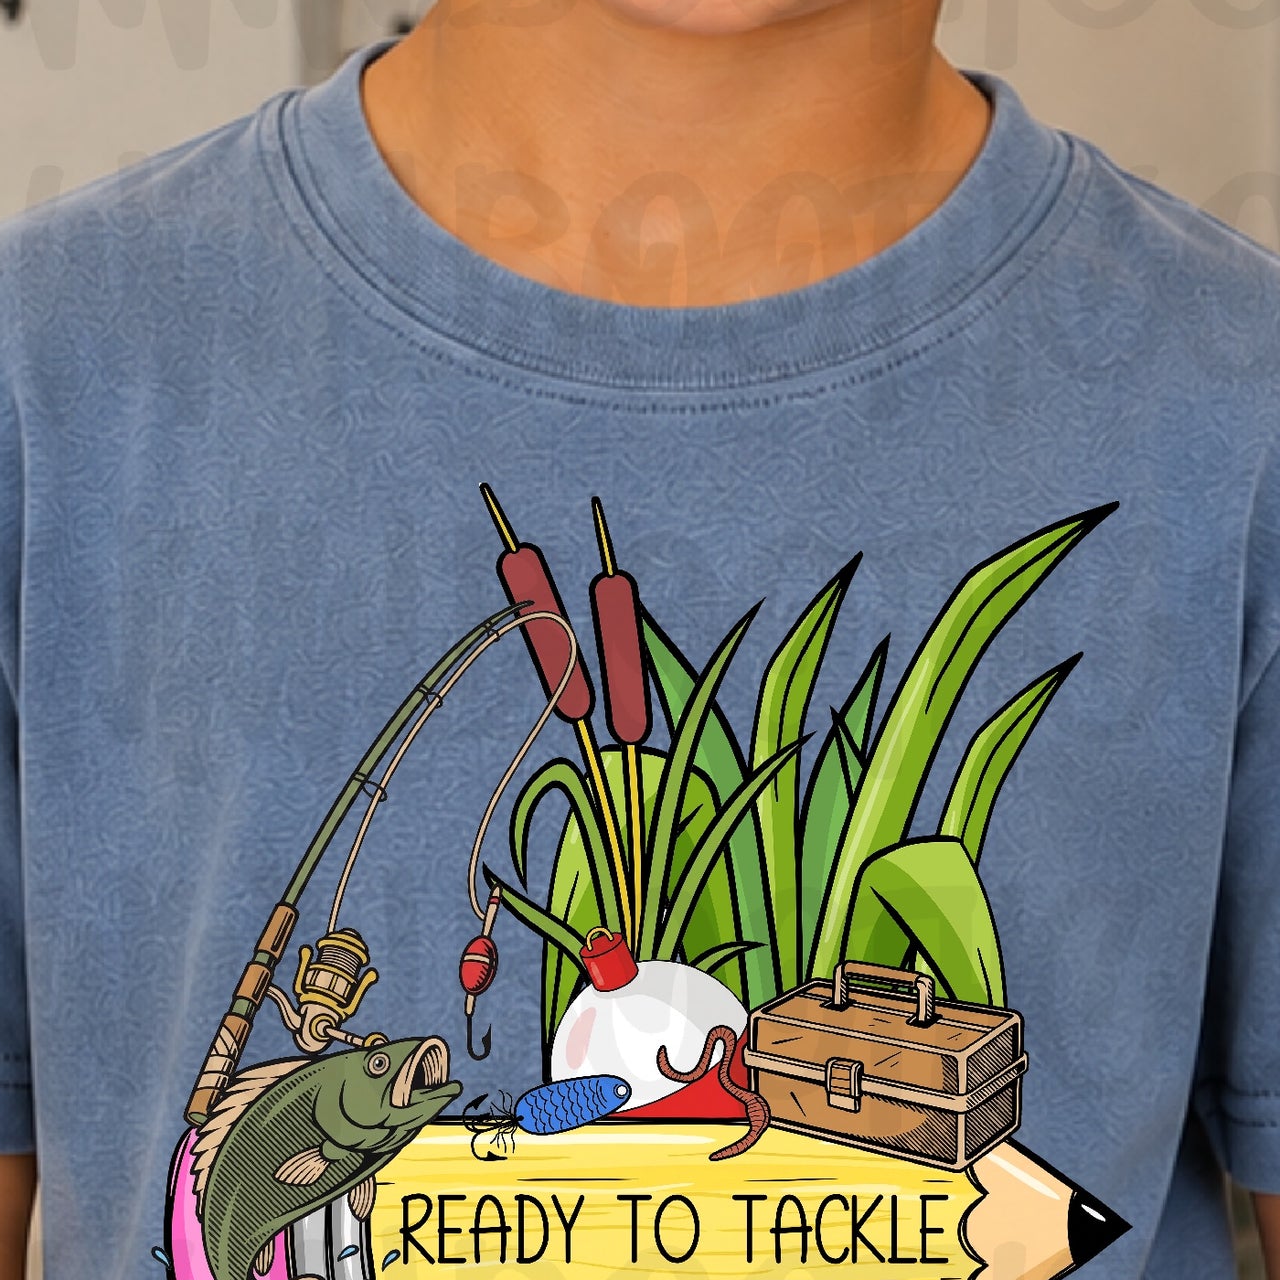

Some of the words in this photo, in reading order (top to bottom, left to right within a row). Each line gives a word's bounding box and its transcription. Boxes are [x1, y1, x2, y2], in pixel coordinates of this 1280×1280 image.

[399, 1192, 586, 1265] READY
[615, 1192, 701, 1265] TO
[731, 1192, 950, 1265] TACKLE
